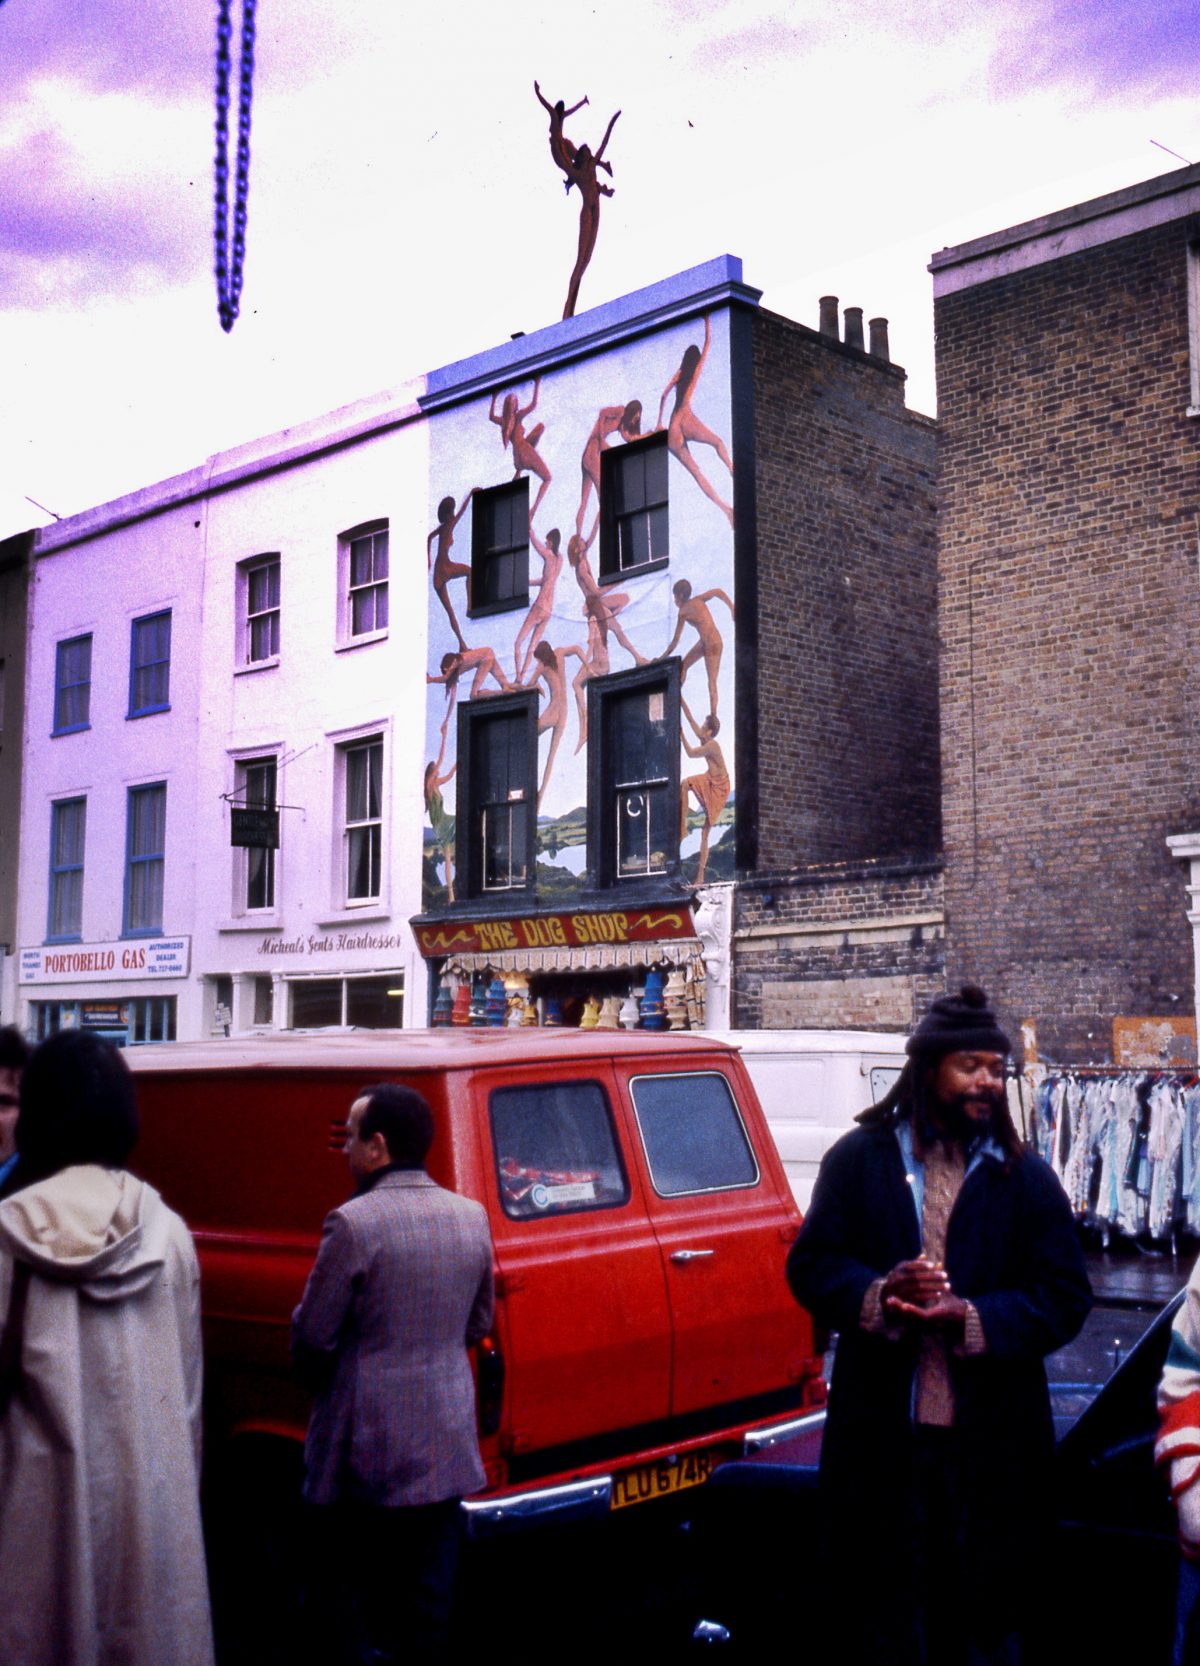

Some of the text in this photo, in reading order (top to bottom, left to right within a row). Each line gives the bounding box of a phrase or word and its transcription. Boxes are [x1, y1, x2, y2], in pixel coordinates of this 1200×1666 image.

[308, 935, 334, 955] Gents
[336, 932, 401, 952] Hairdresser
[473, 912, 629, 951] THE DOG SHOP
[44, 947, 146, 974] PORTOBELLO GAS
[156, 953, 177, 962] DEALER
